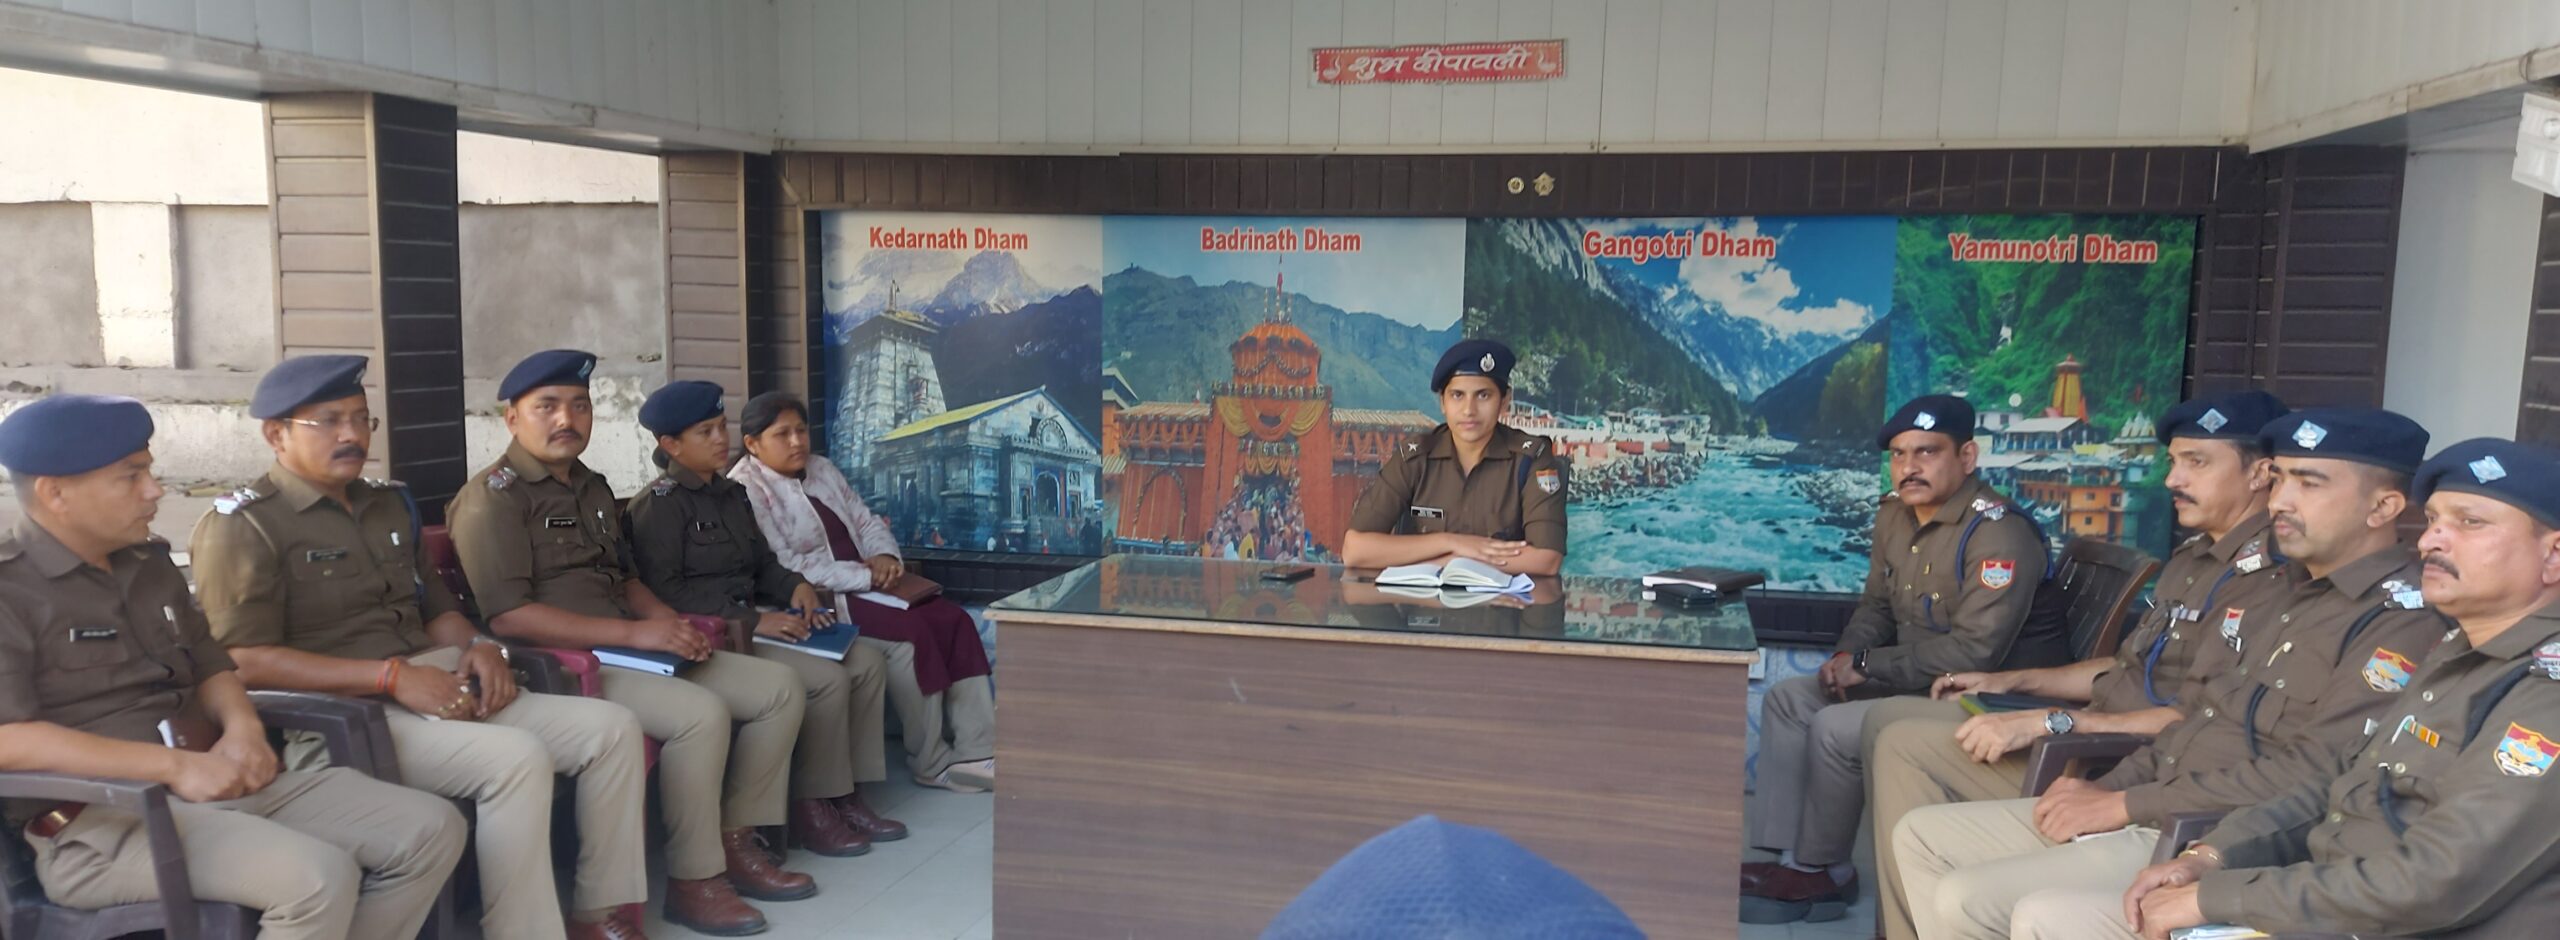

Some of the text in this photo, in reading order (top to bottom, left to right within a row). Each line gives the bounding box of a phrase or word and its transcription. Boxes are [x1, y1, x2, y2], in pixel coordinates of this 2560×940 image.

[1347, 47, 1531, 80] शुभ दीपावली
[869, 226, 1029, 250] Kedarnath Dham
[1201, 227, 1362, 252] Badrinath Dham
[1584, 230, 1776, 263] Gangotri Dham
[1949, 233, 2158, 263] Yamunotri Dham
